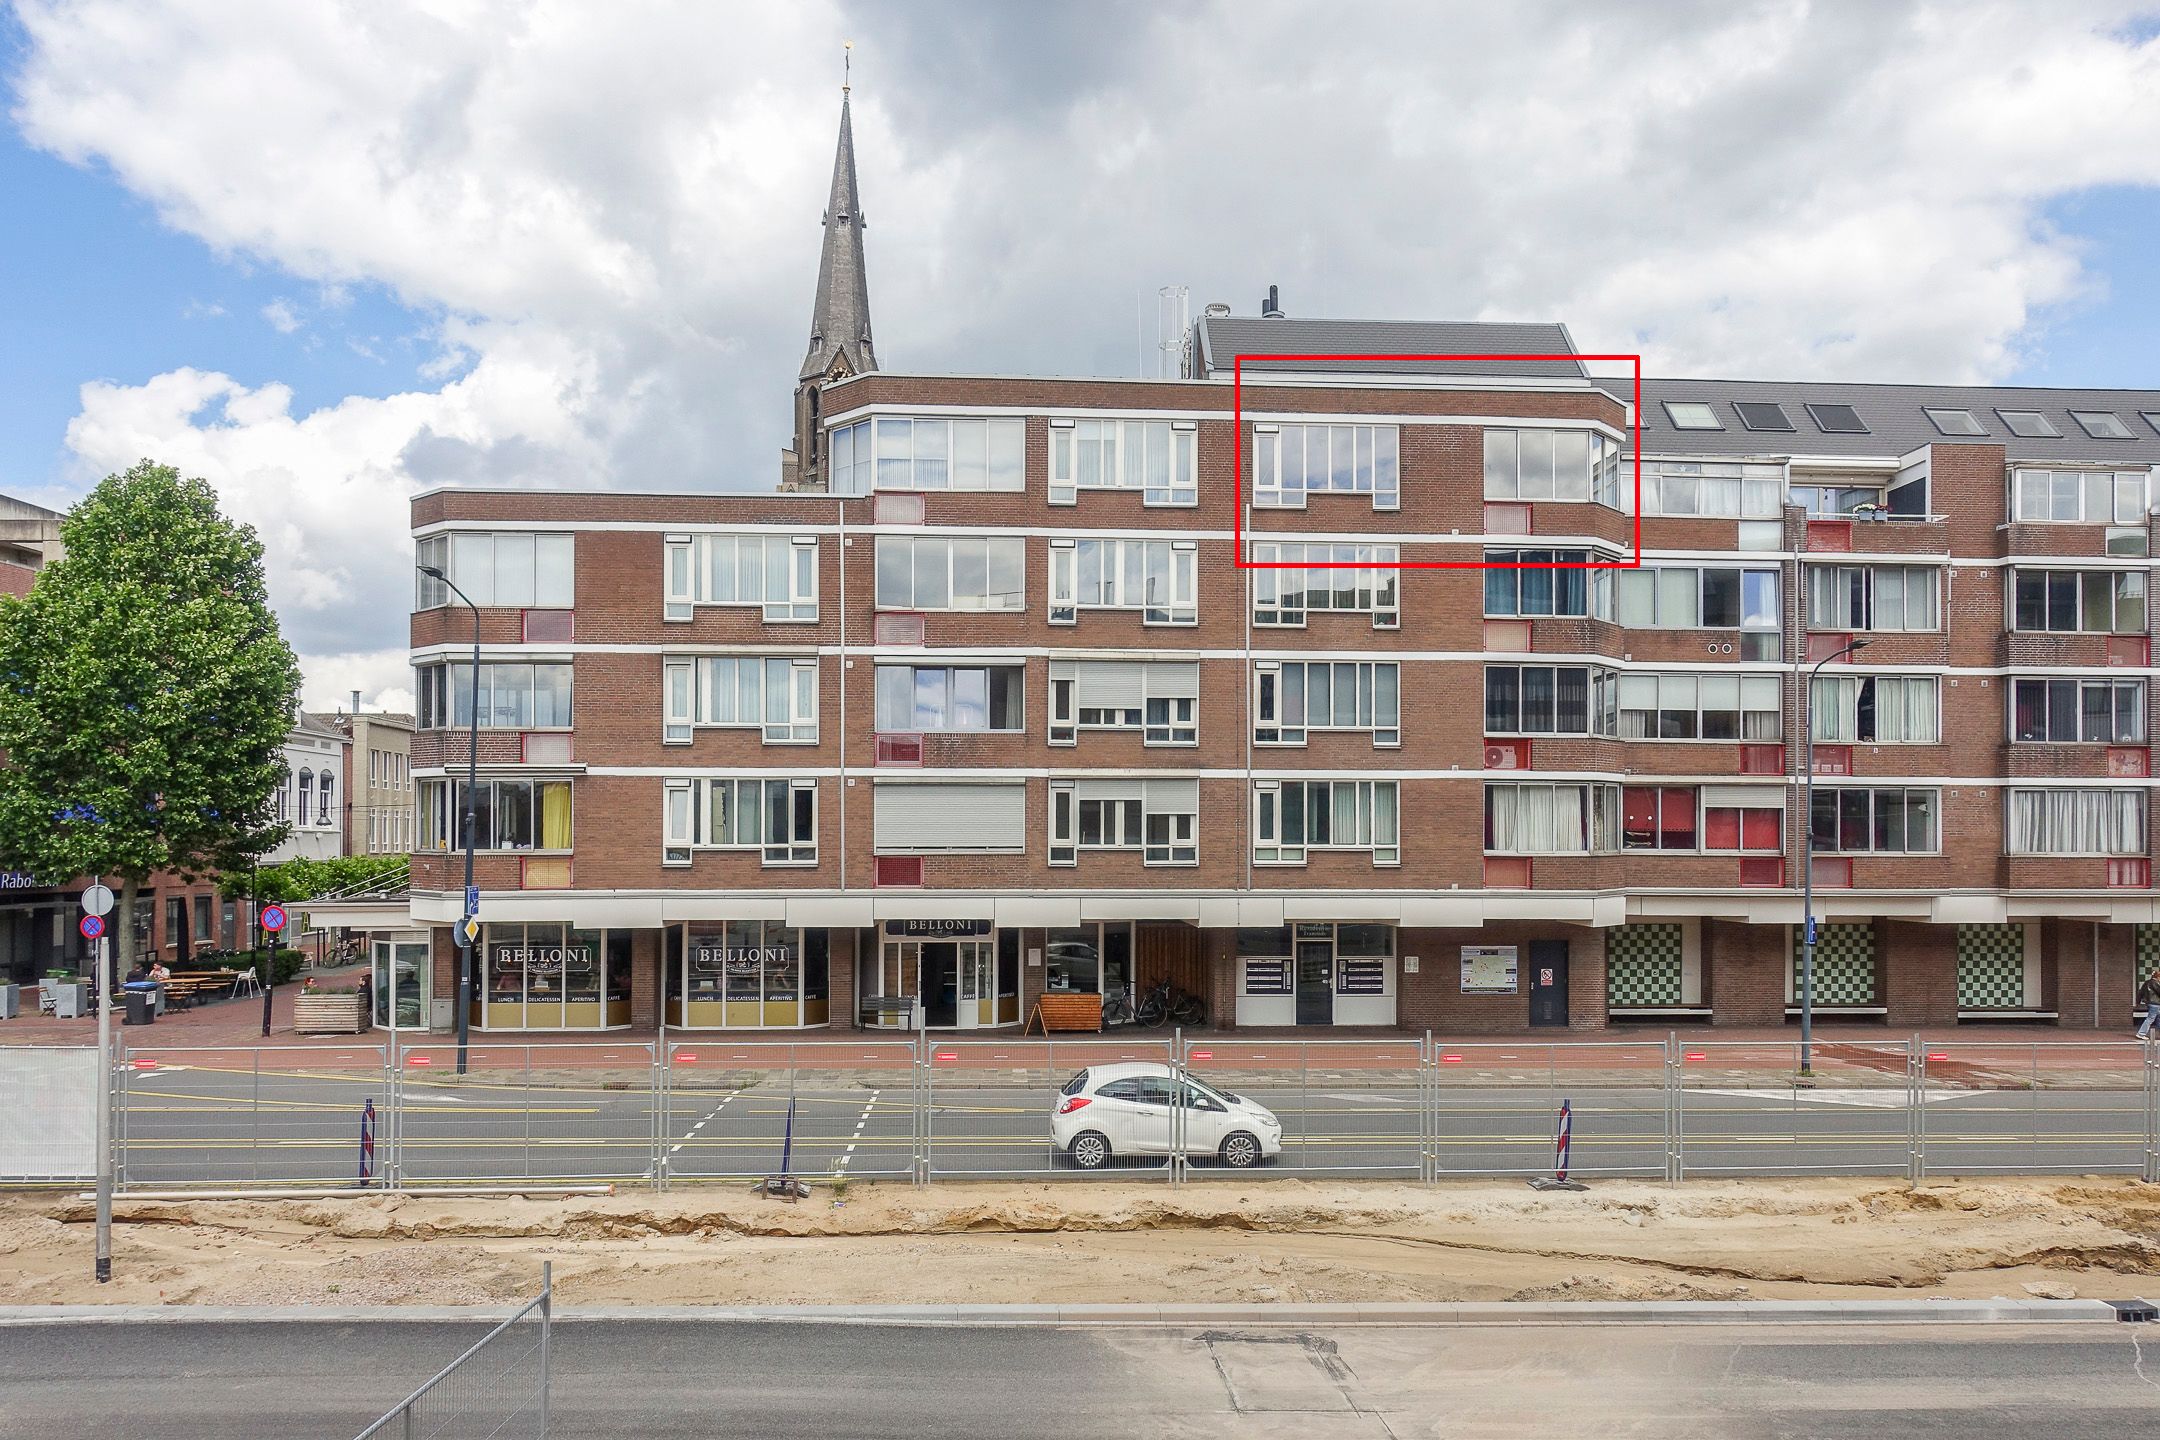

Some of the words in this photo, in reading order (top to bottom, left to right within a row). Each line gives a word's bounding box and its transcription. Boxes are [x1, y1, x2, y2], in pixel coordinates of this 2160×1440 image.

[1, 873, 59, 889] Rabo
[909, 920, 972, 930] BELLONI
[500, 949, 588, 962] BELLONI
[699, 948, 786, 962] BELLONI
